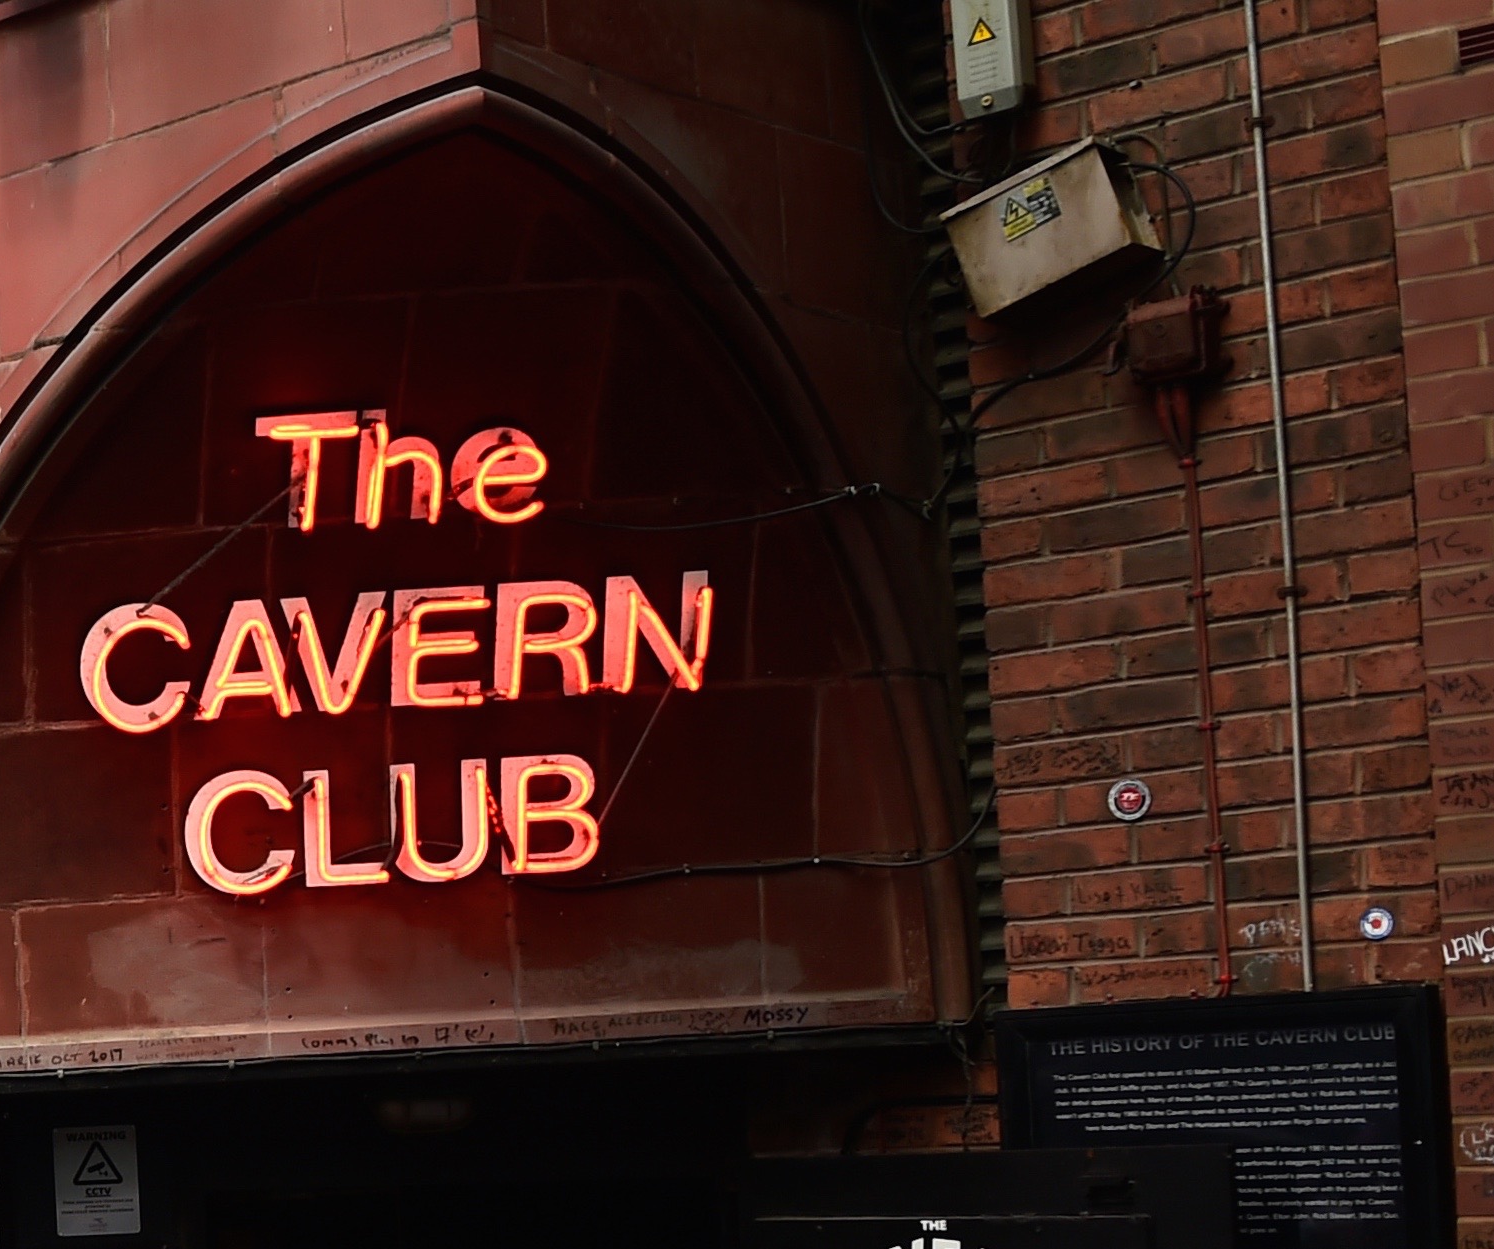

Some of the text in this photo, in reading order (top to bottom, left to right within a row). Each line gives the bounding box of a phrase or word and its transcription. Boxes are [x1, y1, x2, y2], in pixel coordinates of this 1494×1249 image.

[255, 409, 550, 533] The
[80, 570, 714, 735] CAVERN
[185, 753, 601, 896] CLUB
[742, 1006, 810, 1026] MOSSY
[1049, 1024, 1397, 1057] THE HISTORY OF THE CAVERN CLUB
[51, 1053, 83, 1067] OCT
[88, 1048, 124, 1064] 2017
[65, 1130, 127, 1142] WARNING
[84, 1187, 112, 1197] CCTV
[919, 1219, 948, 1232] THE
